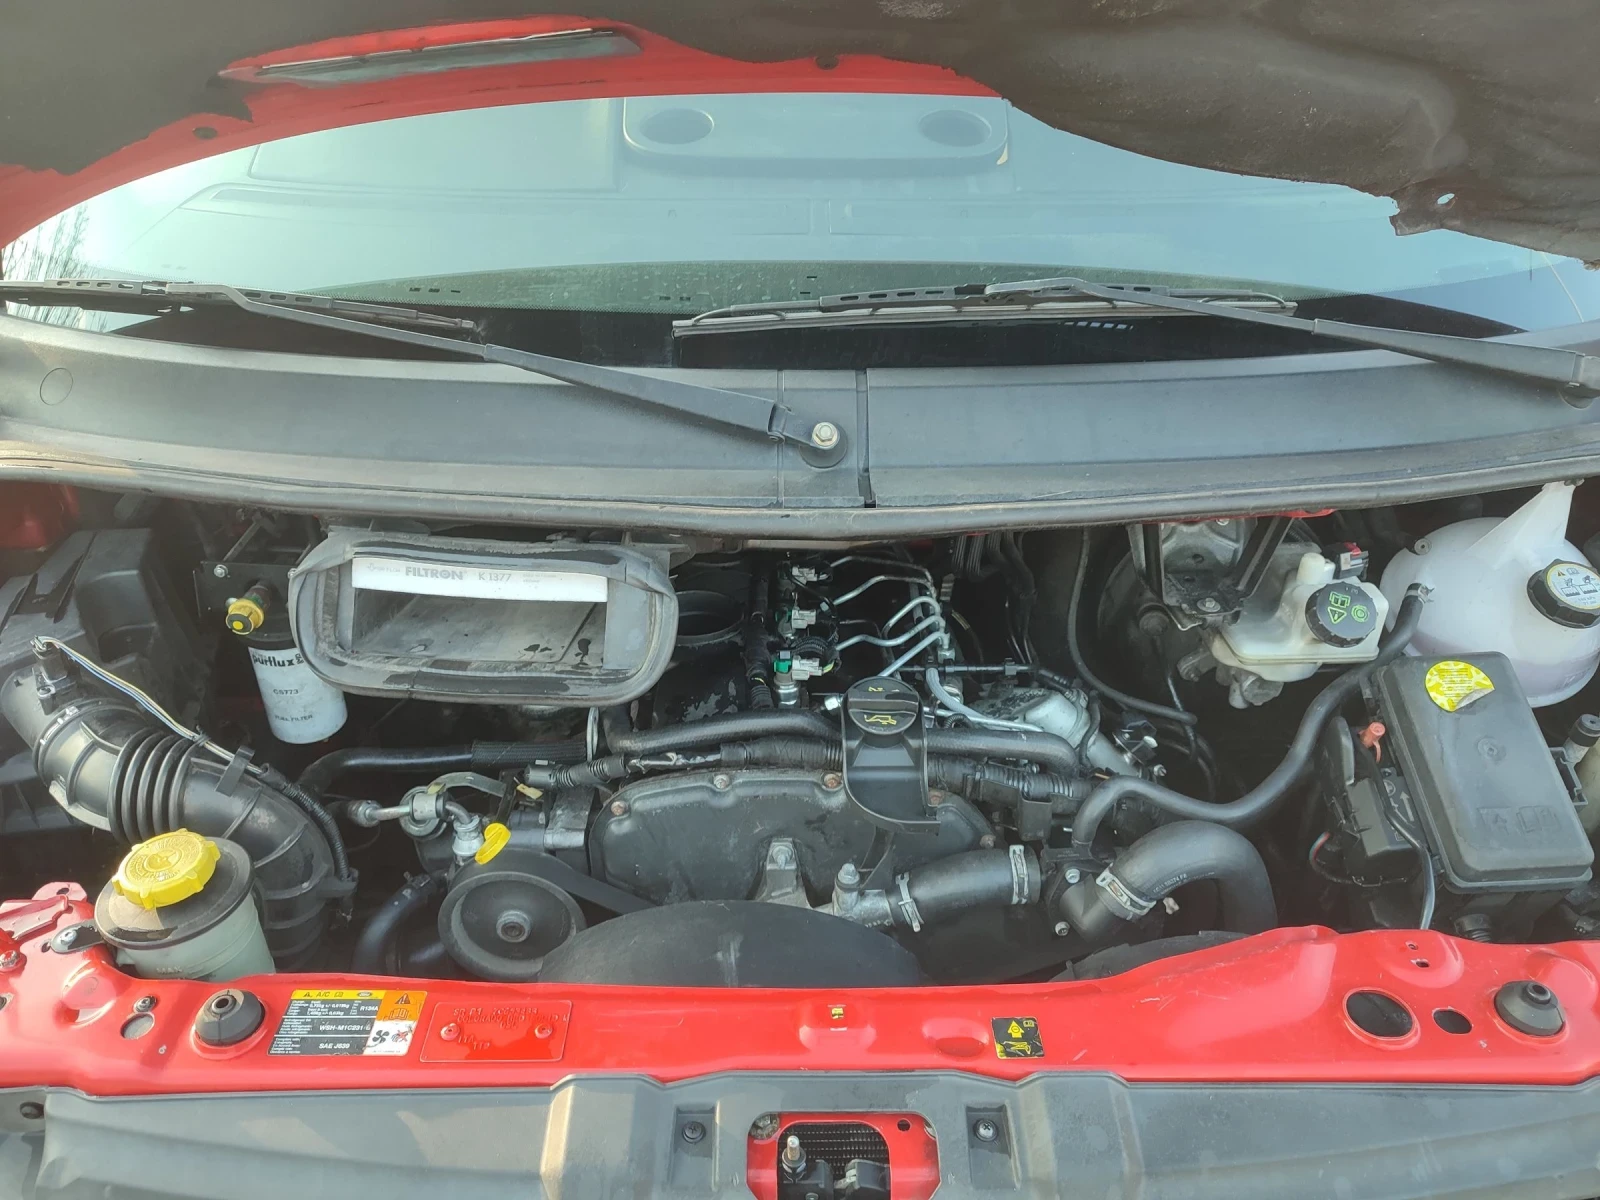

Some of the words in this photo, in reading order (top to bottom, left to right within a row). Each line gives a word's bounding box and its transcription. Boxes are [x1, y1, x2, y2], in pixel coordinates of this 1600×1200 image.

[405, 566, 464, 581] FILTRON
[478, 571, 486, 581] K
[489, 573, 512, 583] 1377
